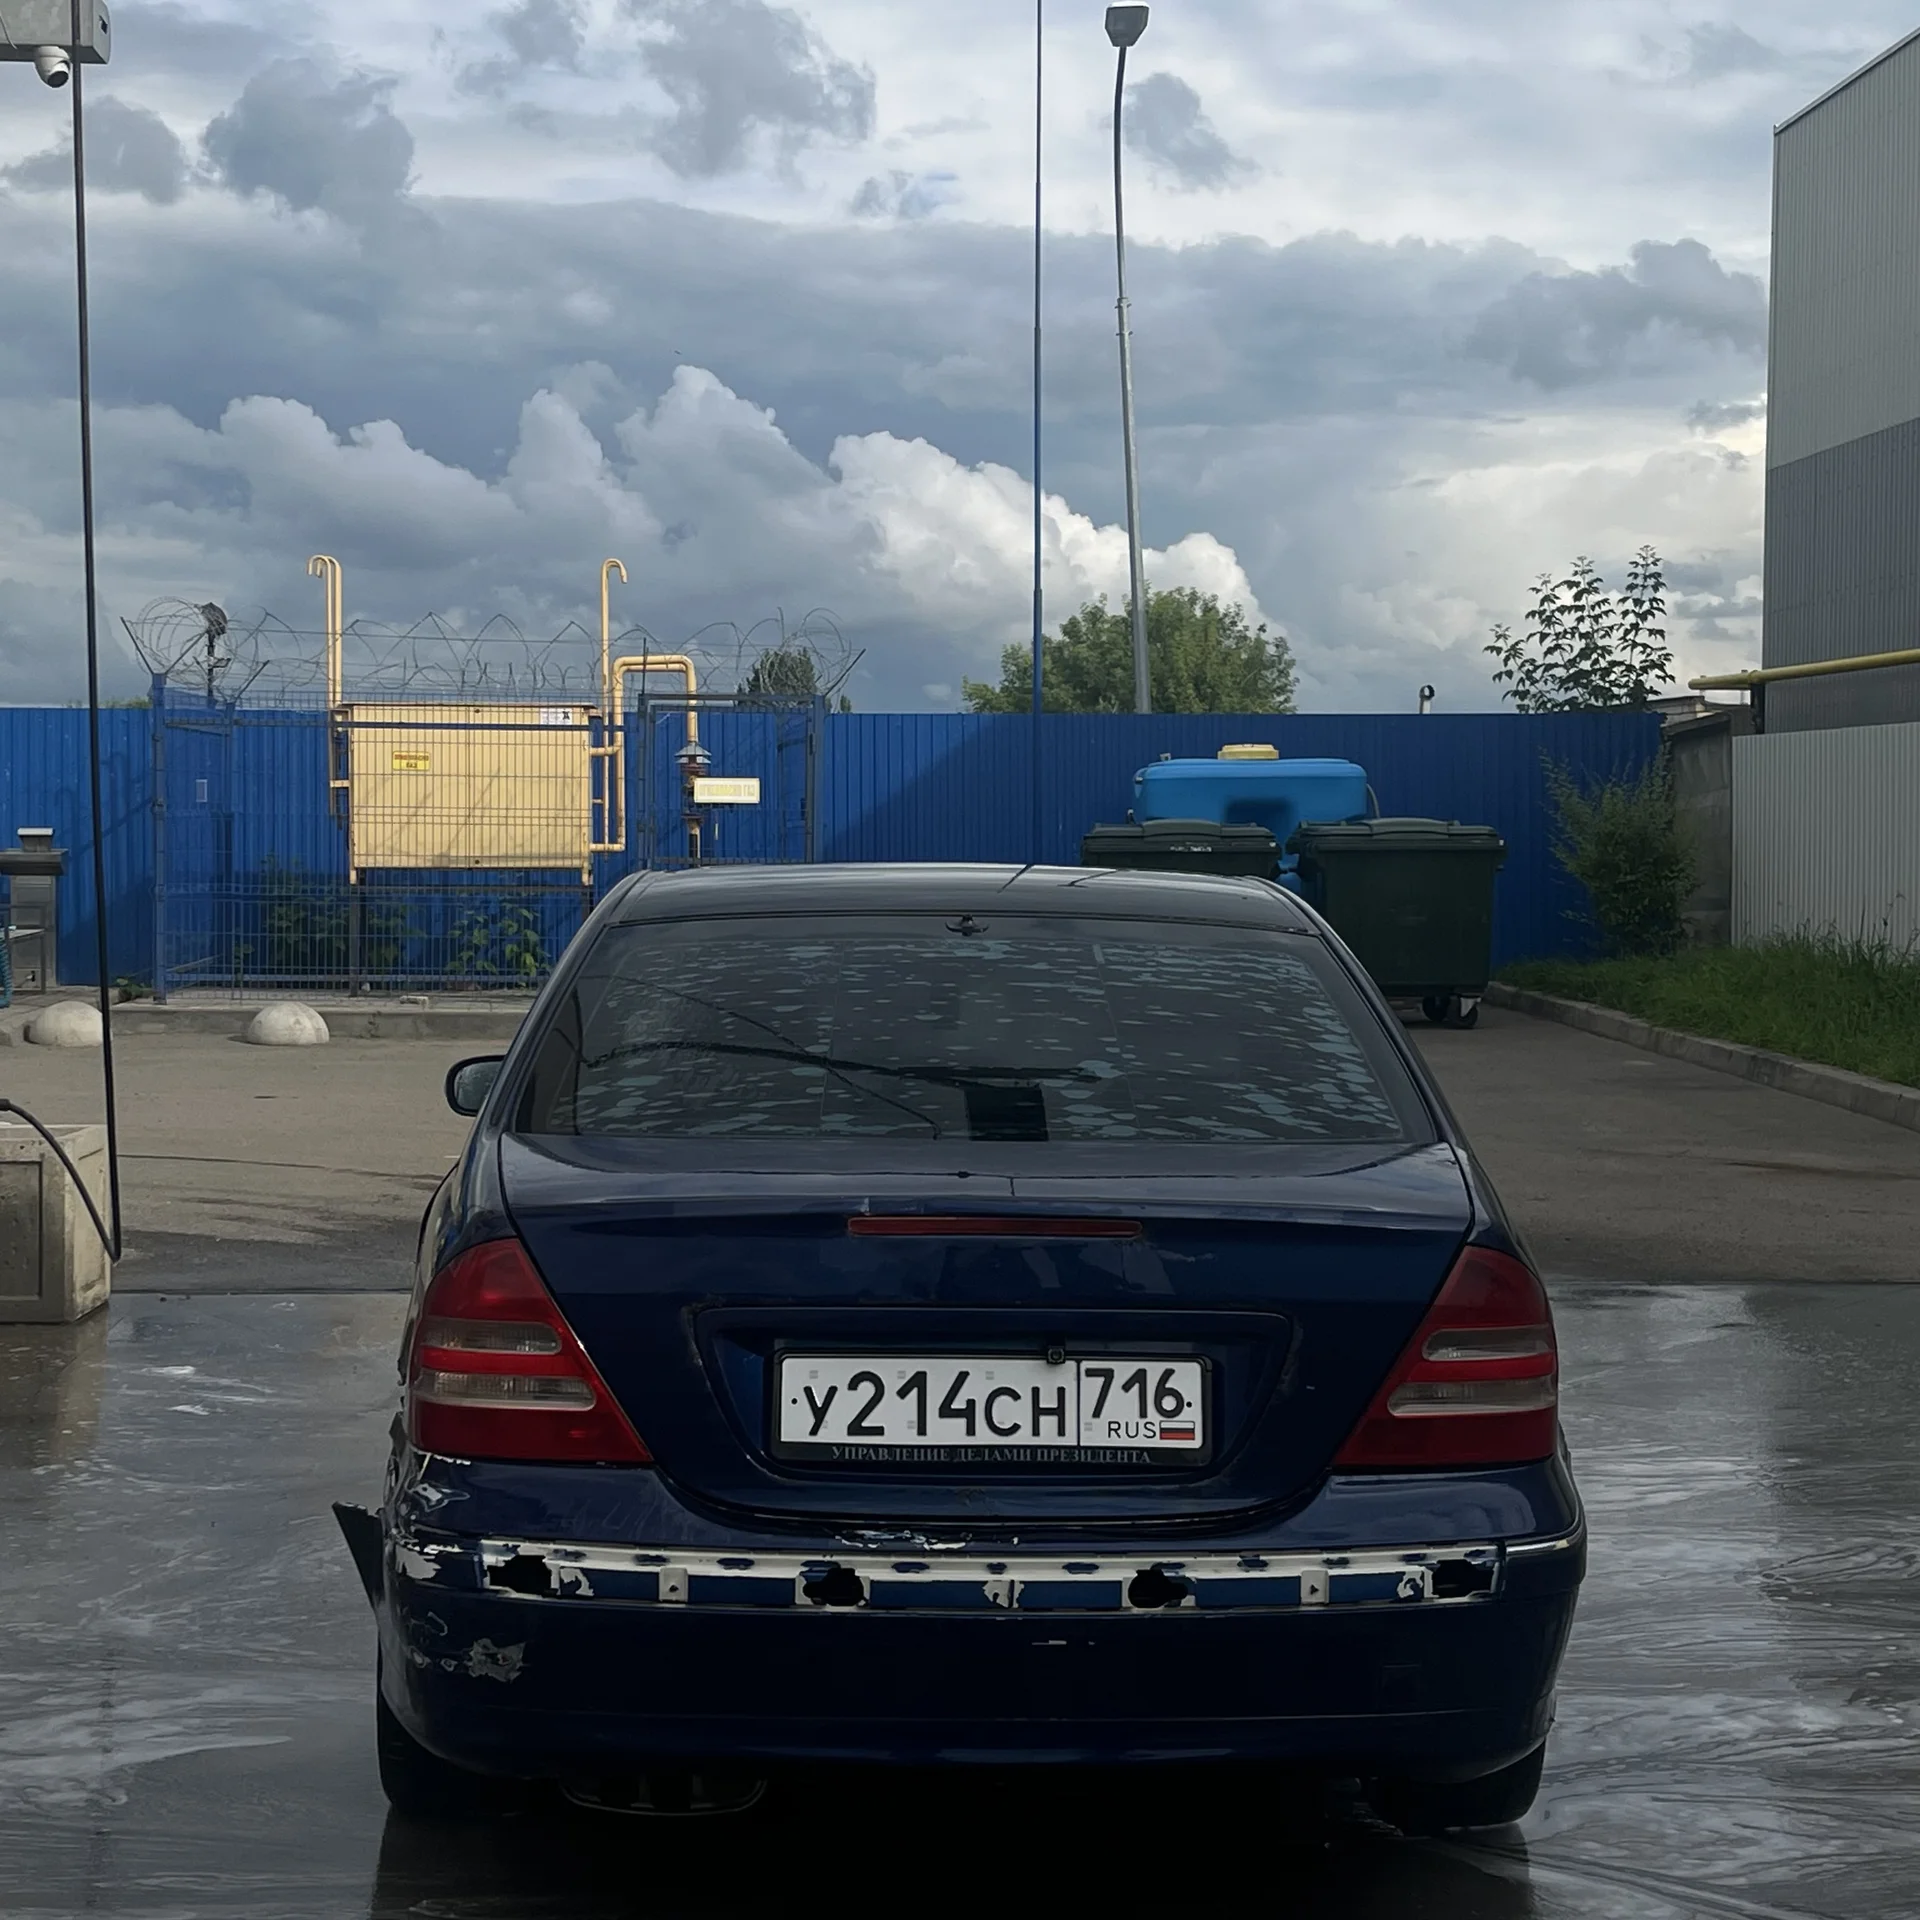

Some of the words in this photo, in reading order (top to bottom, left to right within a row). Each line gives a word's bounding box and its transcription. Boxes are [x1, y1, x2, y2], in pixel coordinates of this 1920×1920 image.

[1085, 1368, 1185, 1419] 716
[1107, 1421, 1157, 1438] RUS
[831, 1445, 951, 1462] УПРАВЛЕНИЕ
[953, 1447, 1033, 1463] ДЕЛАМИ
[1036, 1448, 1152, 1464] ПРЕЗИДЕНТА
